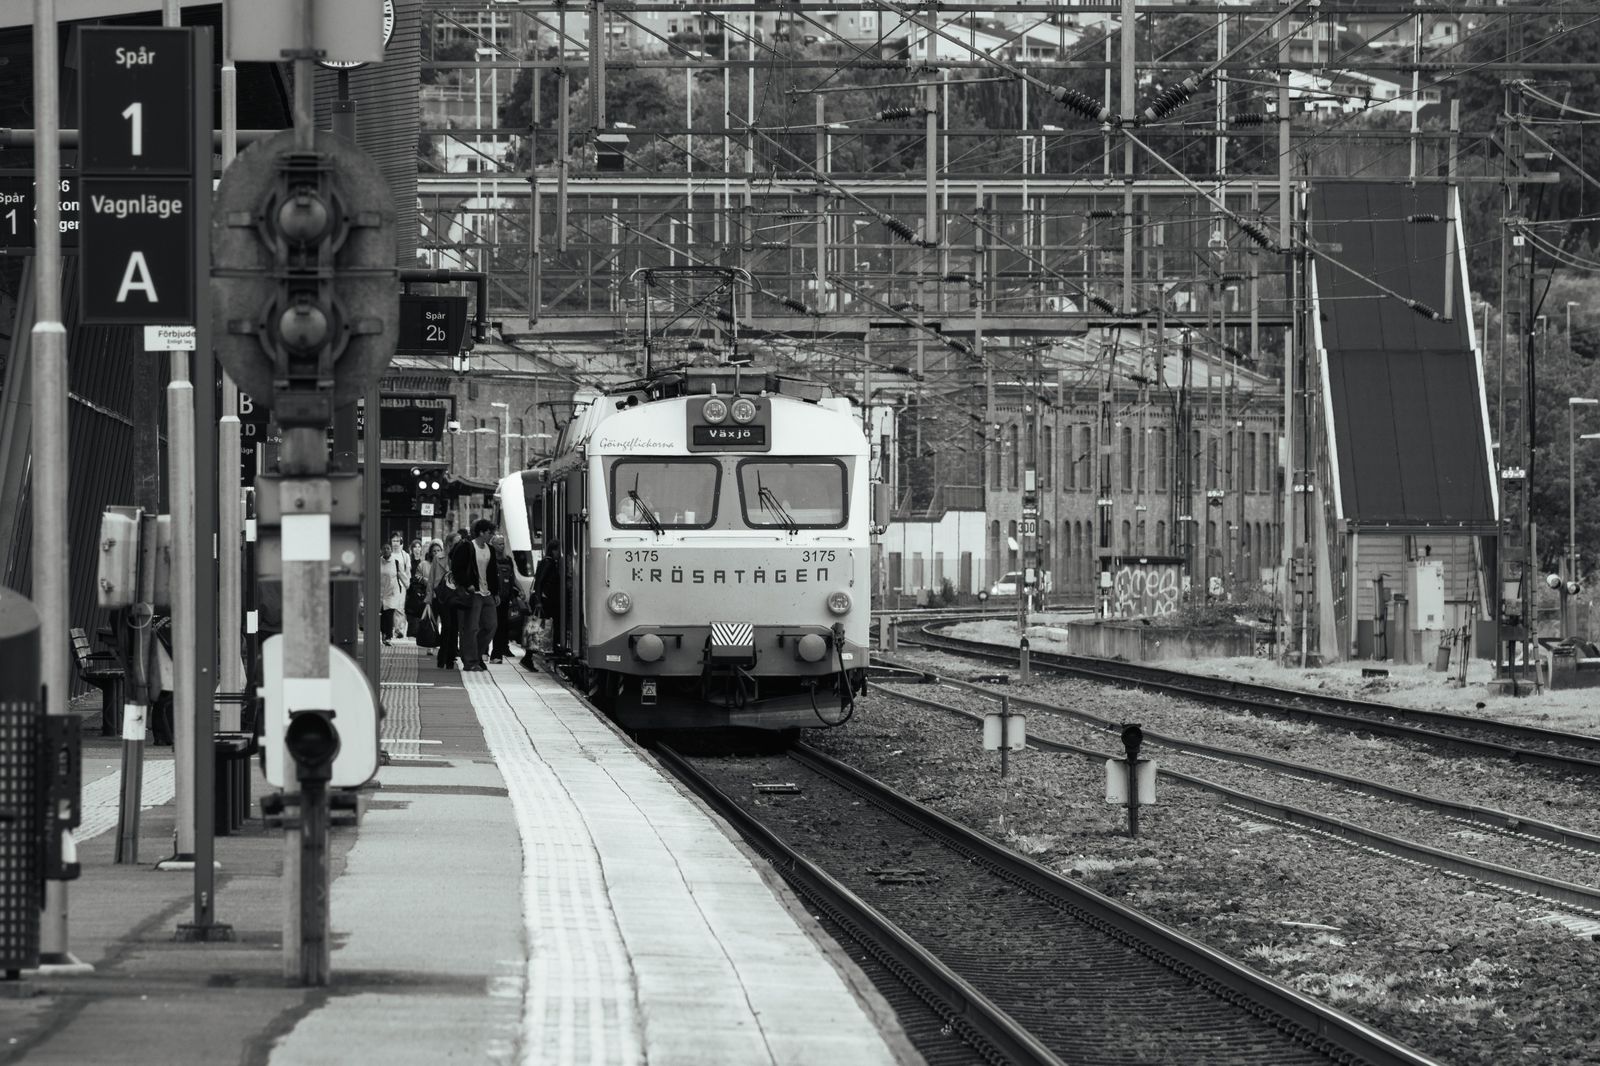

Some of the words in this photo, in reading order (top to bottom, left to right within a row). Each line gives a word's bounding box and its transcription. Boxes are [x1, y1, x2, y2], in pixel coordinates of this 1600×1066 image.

[116, 47, 156, 68] Spår
[121, 102, 142, 156] 1
[92, 194, 183, 219] Vagnläge
[5, 209, 17, 235] 1
[116, 251, 159, 303] A
[425, 311, 446, 321] Spår
[426, 324, 446, 341] 2b
[421, 423, 434, 434] 2b
[709, 429, 751, 439] Växjö
[1502, 470, 1525, 478] 69-9
[625, 550, 659, 562] 3175
[802, 550, 836, 562] 3175
